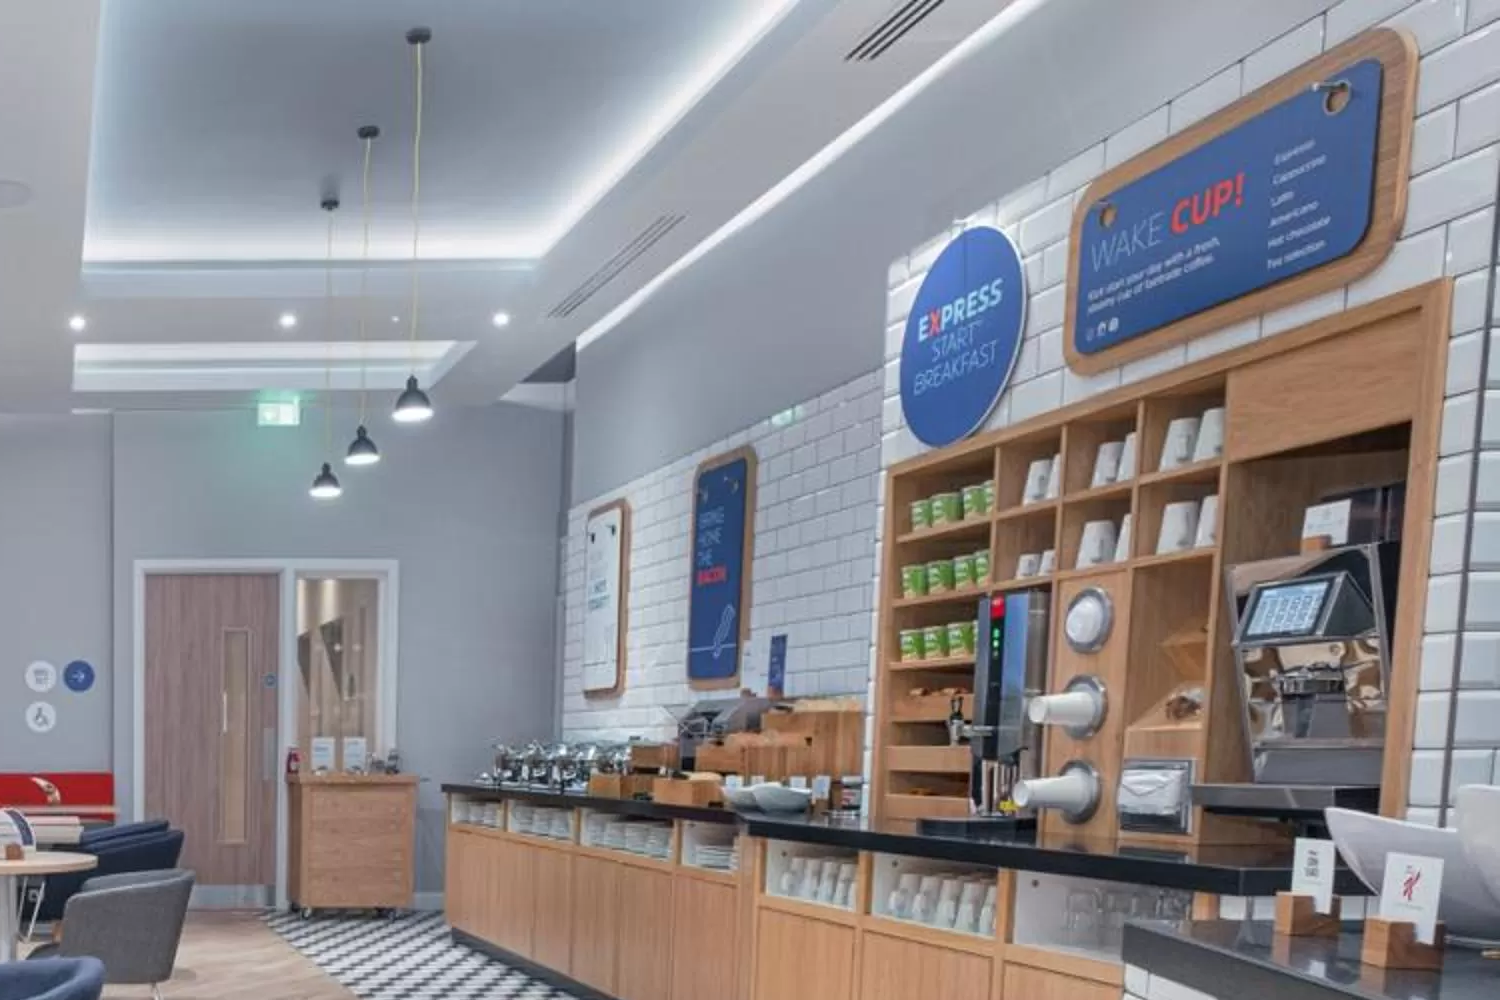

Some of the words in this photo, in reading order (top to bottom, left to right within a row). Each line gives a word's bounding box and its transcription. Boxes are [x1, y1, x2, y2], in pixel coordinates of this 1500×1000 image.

[1091, 211, 1164, 273] WAKE
[1171, 171, 1245, 234] CUP!
[918, 277, 1004, 343] EXPRESS
[932, 319, 983, 362] START
[914, 340, 998, 396] BREAKFAST
